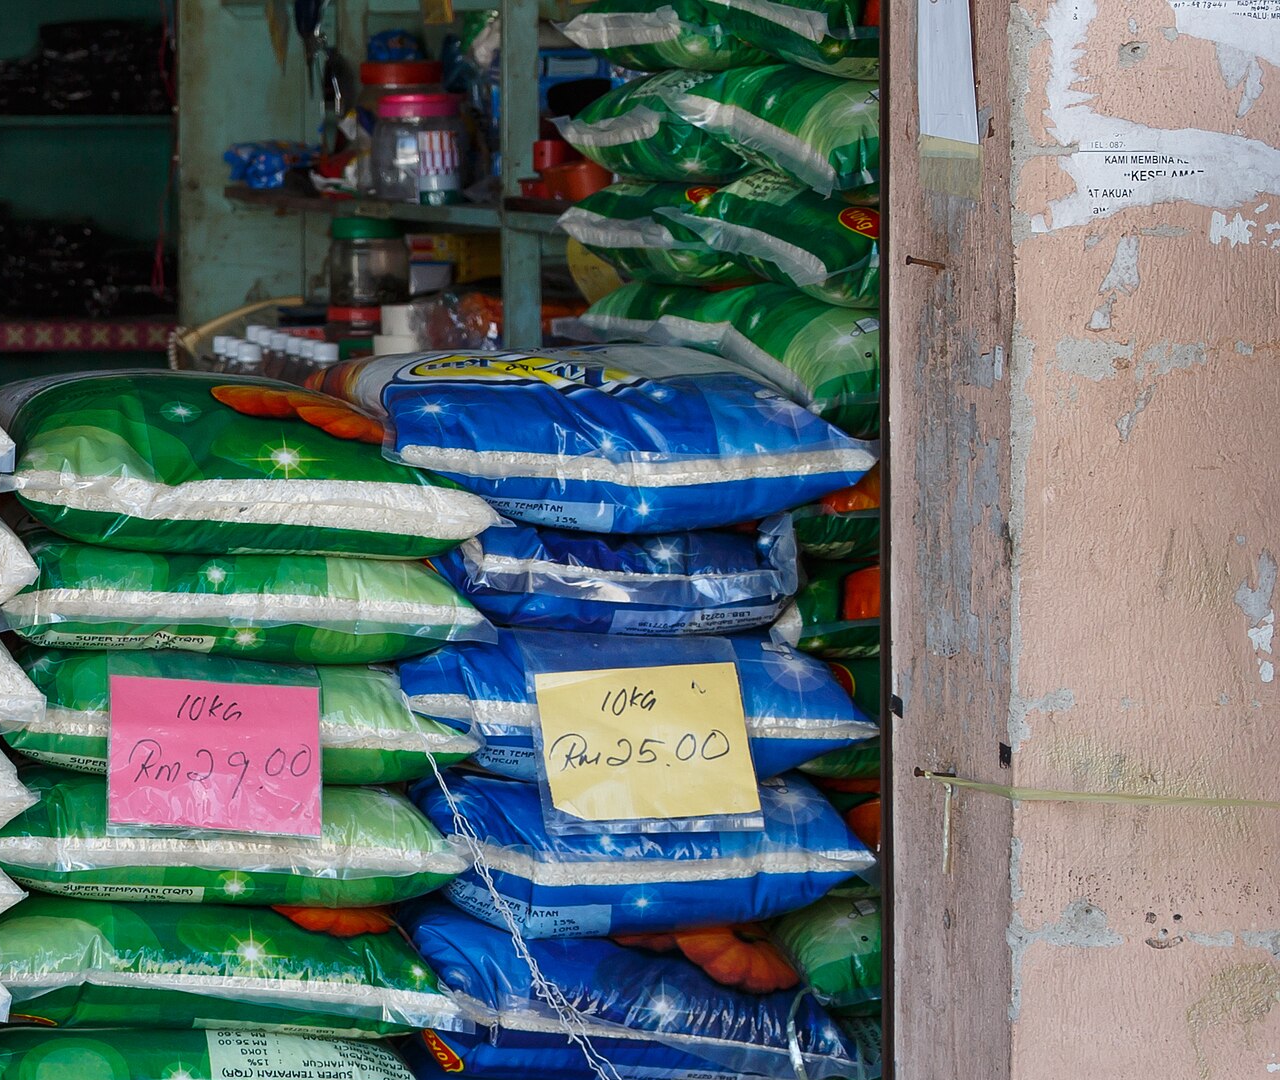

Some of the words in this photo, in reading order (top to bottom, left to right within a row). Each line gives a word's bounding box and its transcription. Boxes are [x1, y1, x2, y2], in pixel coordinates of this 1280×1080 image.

[1105, 156, 1128, 164] KAMI
[1131, 156, 1174, 164] MEMBINA
[63, 884, 100, 892] SUPER
[102, 886, 159, 894] TEMPATAN
[162, 888, 193, 896] (TQR)
[222, 1068, 254, 1078] (TQR)
[256, 1070, 314, 1079] TEMPATAN
[317, 1070, 353, 1079] SUPER
